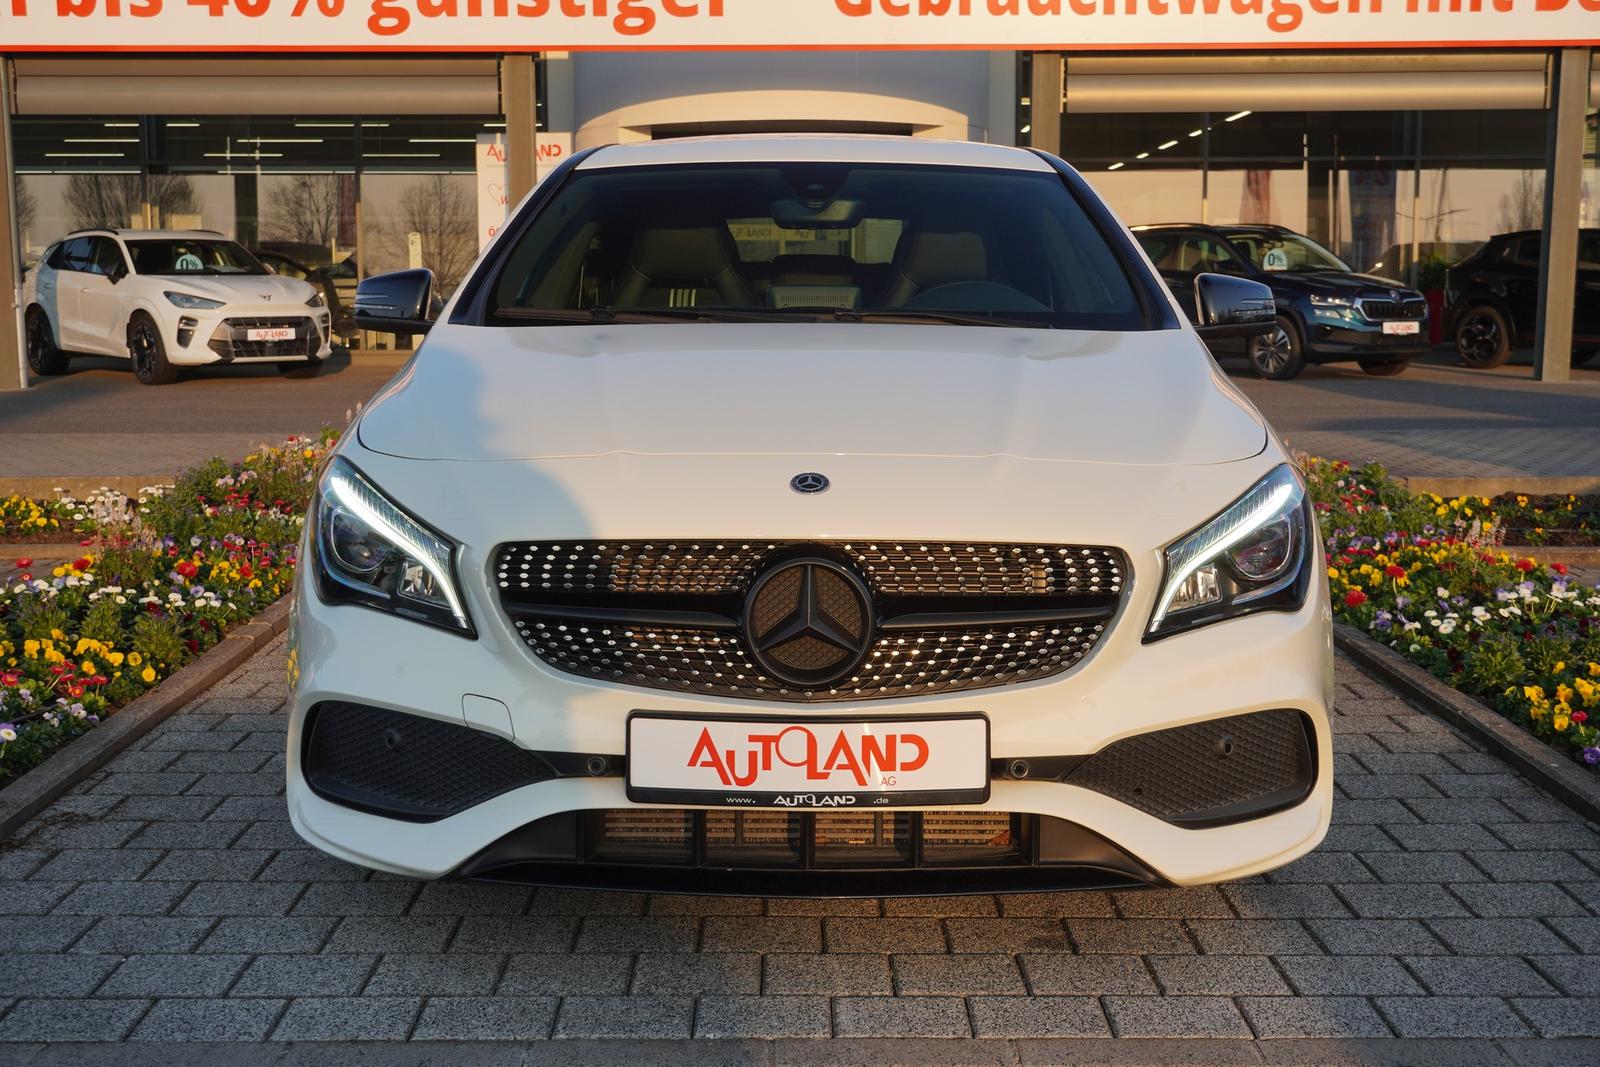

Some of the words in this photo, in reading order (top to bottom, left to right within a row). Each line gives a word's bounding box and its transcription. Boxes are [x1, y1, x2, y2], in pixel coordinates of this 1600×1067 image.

[687, 725, 930, 787] AUTOLAND
[880, 775, 897, 787] AG
[726, 796, 756, 804] www.
[773, 793, 856, 807] AUTOLAND
[873, 796, 889, 805] .de
